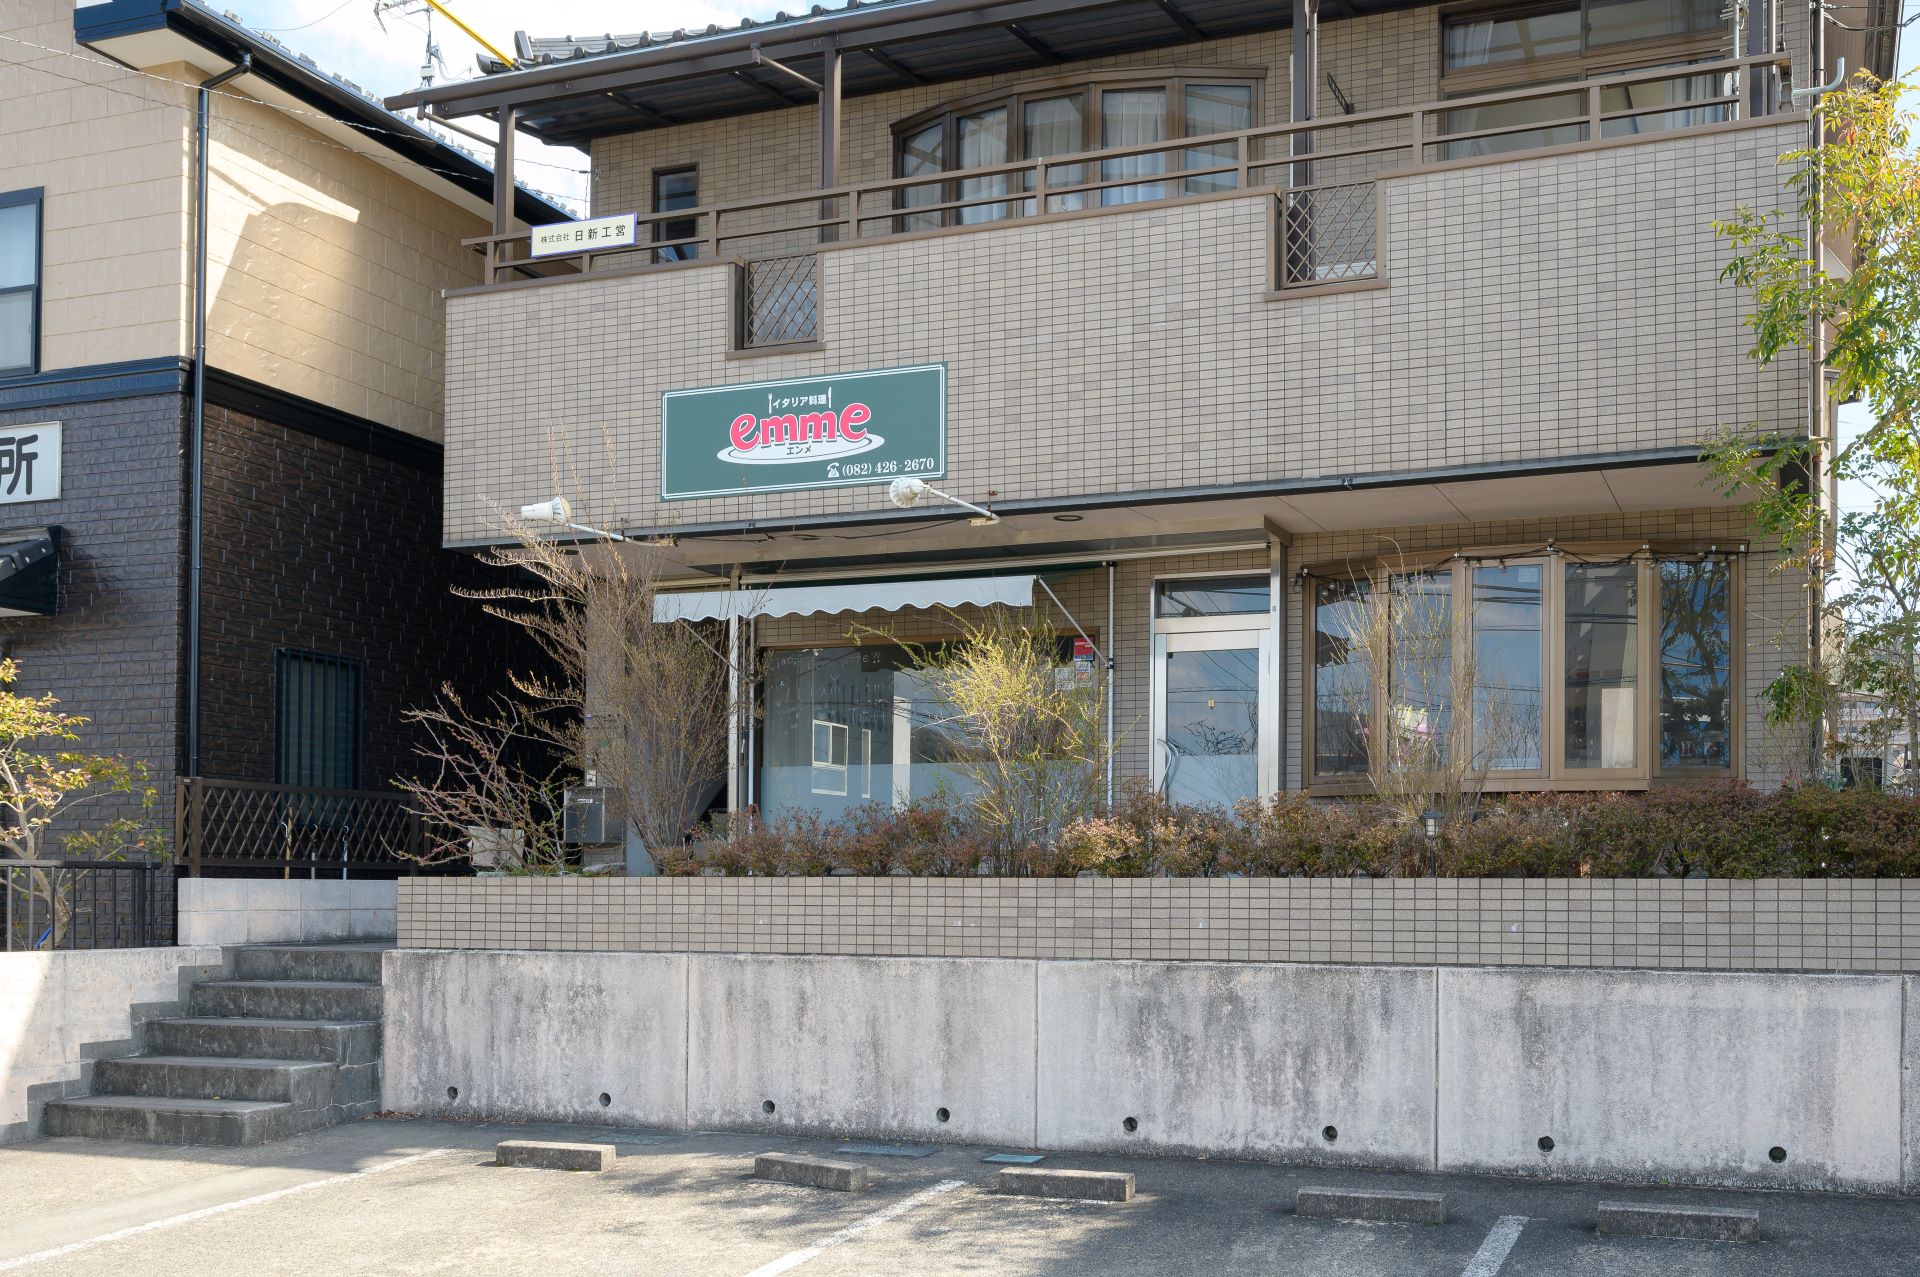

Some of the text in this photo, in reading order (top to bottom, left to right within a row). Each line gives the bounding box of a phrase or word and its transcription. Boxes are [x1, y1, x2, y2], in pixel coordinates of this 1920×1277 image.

[540, 224, 626, 244] 株式会社 日新工営
[772, 394, 827, 409] イタリア料理
[729, 402, 872, 452] emme
[786, 444, 812, 456] エンメ
[0, 434, 39, 496] 所
[842, 457, 935, 477] (082) 426-2670
